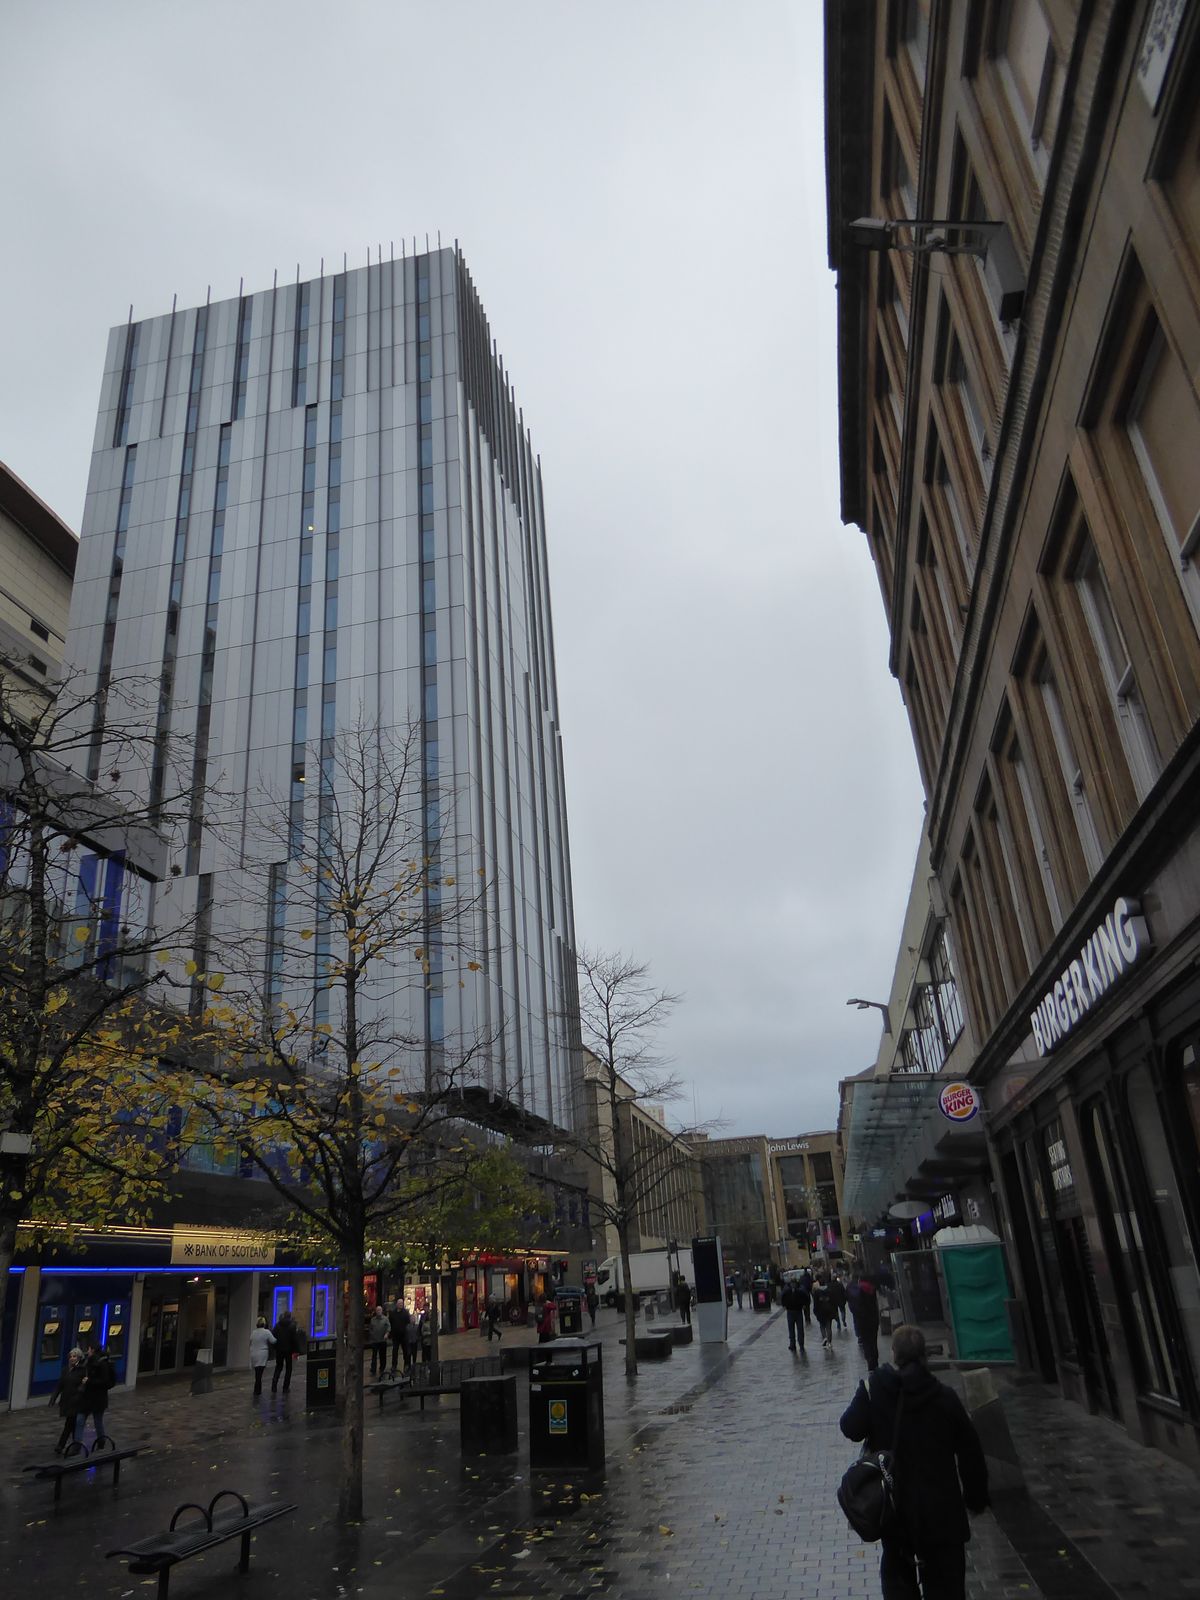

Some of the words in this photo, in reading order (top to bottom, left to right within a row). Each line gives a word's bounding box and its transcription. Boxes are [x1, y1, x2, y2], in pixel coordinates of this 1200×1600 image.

[1030, 959, 1090, 1057] BURGER
[1081, 897, 1138, 1002] KING
[943, 1088, 971, 1105] BURGER
[945, 1095, 974, 1114] KING
[768, 1143, 786, 1153] John
[787, 1140, 809, 1151] Lewis
[195, 1244, 217, 1257] BANK
[218, 1245, 231, 1257] OF
[231, 1245, 269, 1259] SCOTLAND
